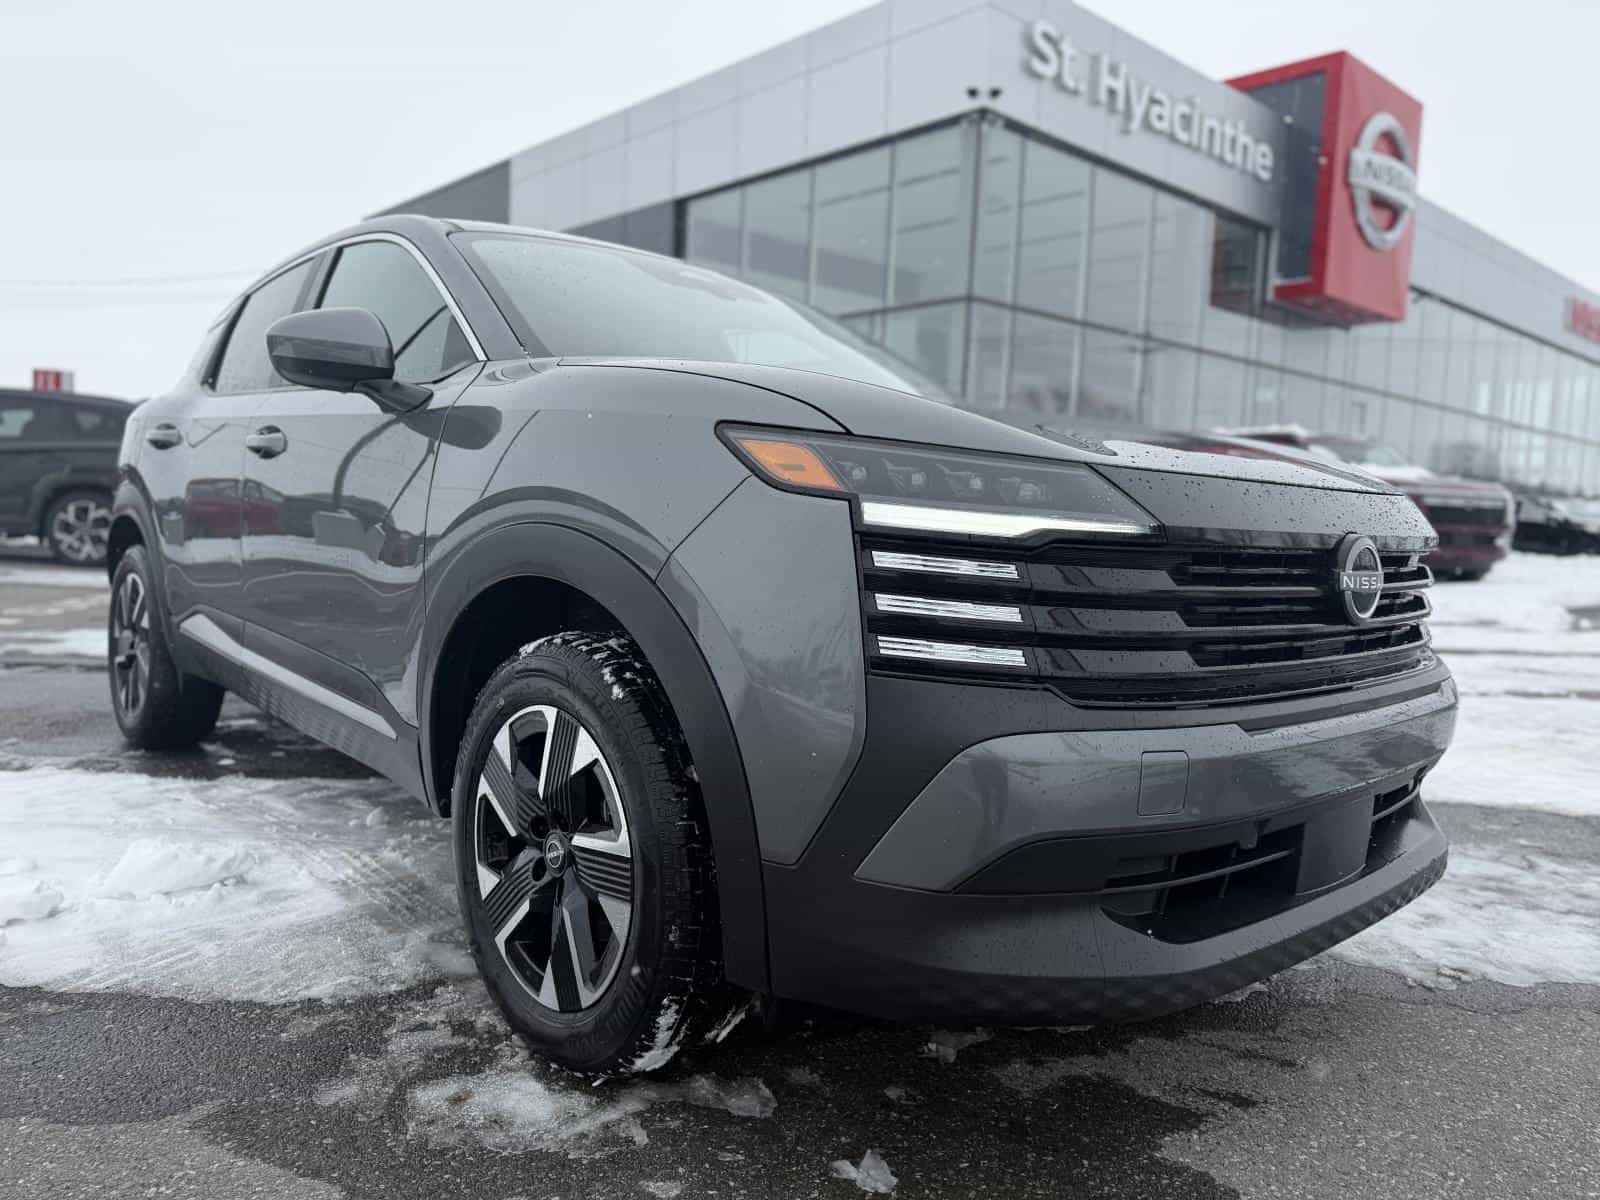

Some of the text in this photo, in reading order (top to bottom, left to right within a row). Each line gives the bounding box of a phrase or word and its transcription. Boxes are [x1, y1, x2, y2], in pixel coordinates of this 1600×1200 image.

[1027, 19, 1275, 182] St. Hyacinthe
[1343, 575, 1377, 589] NISS
